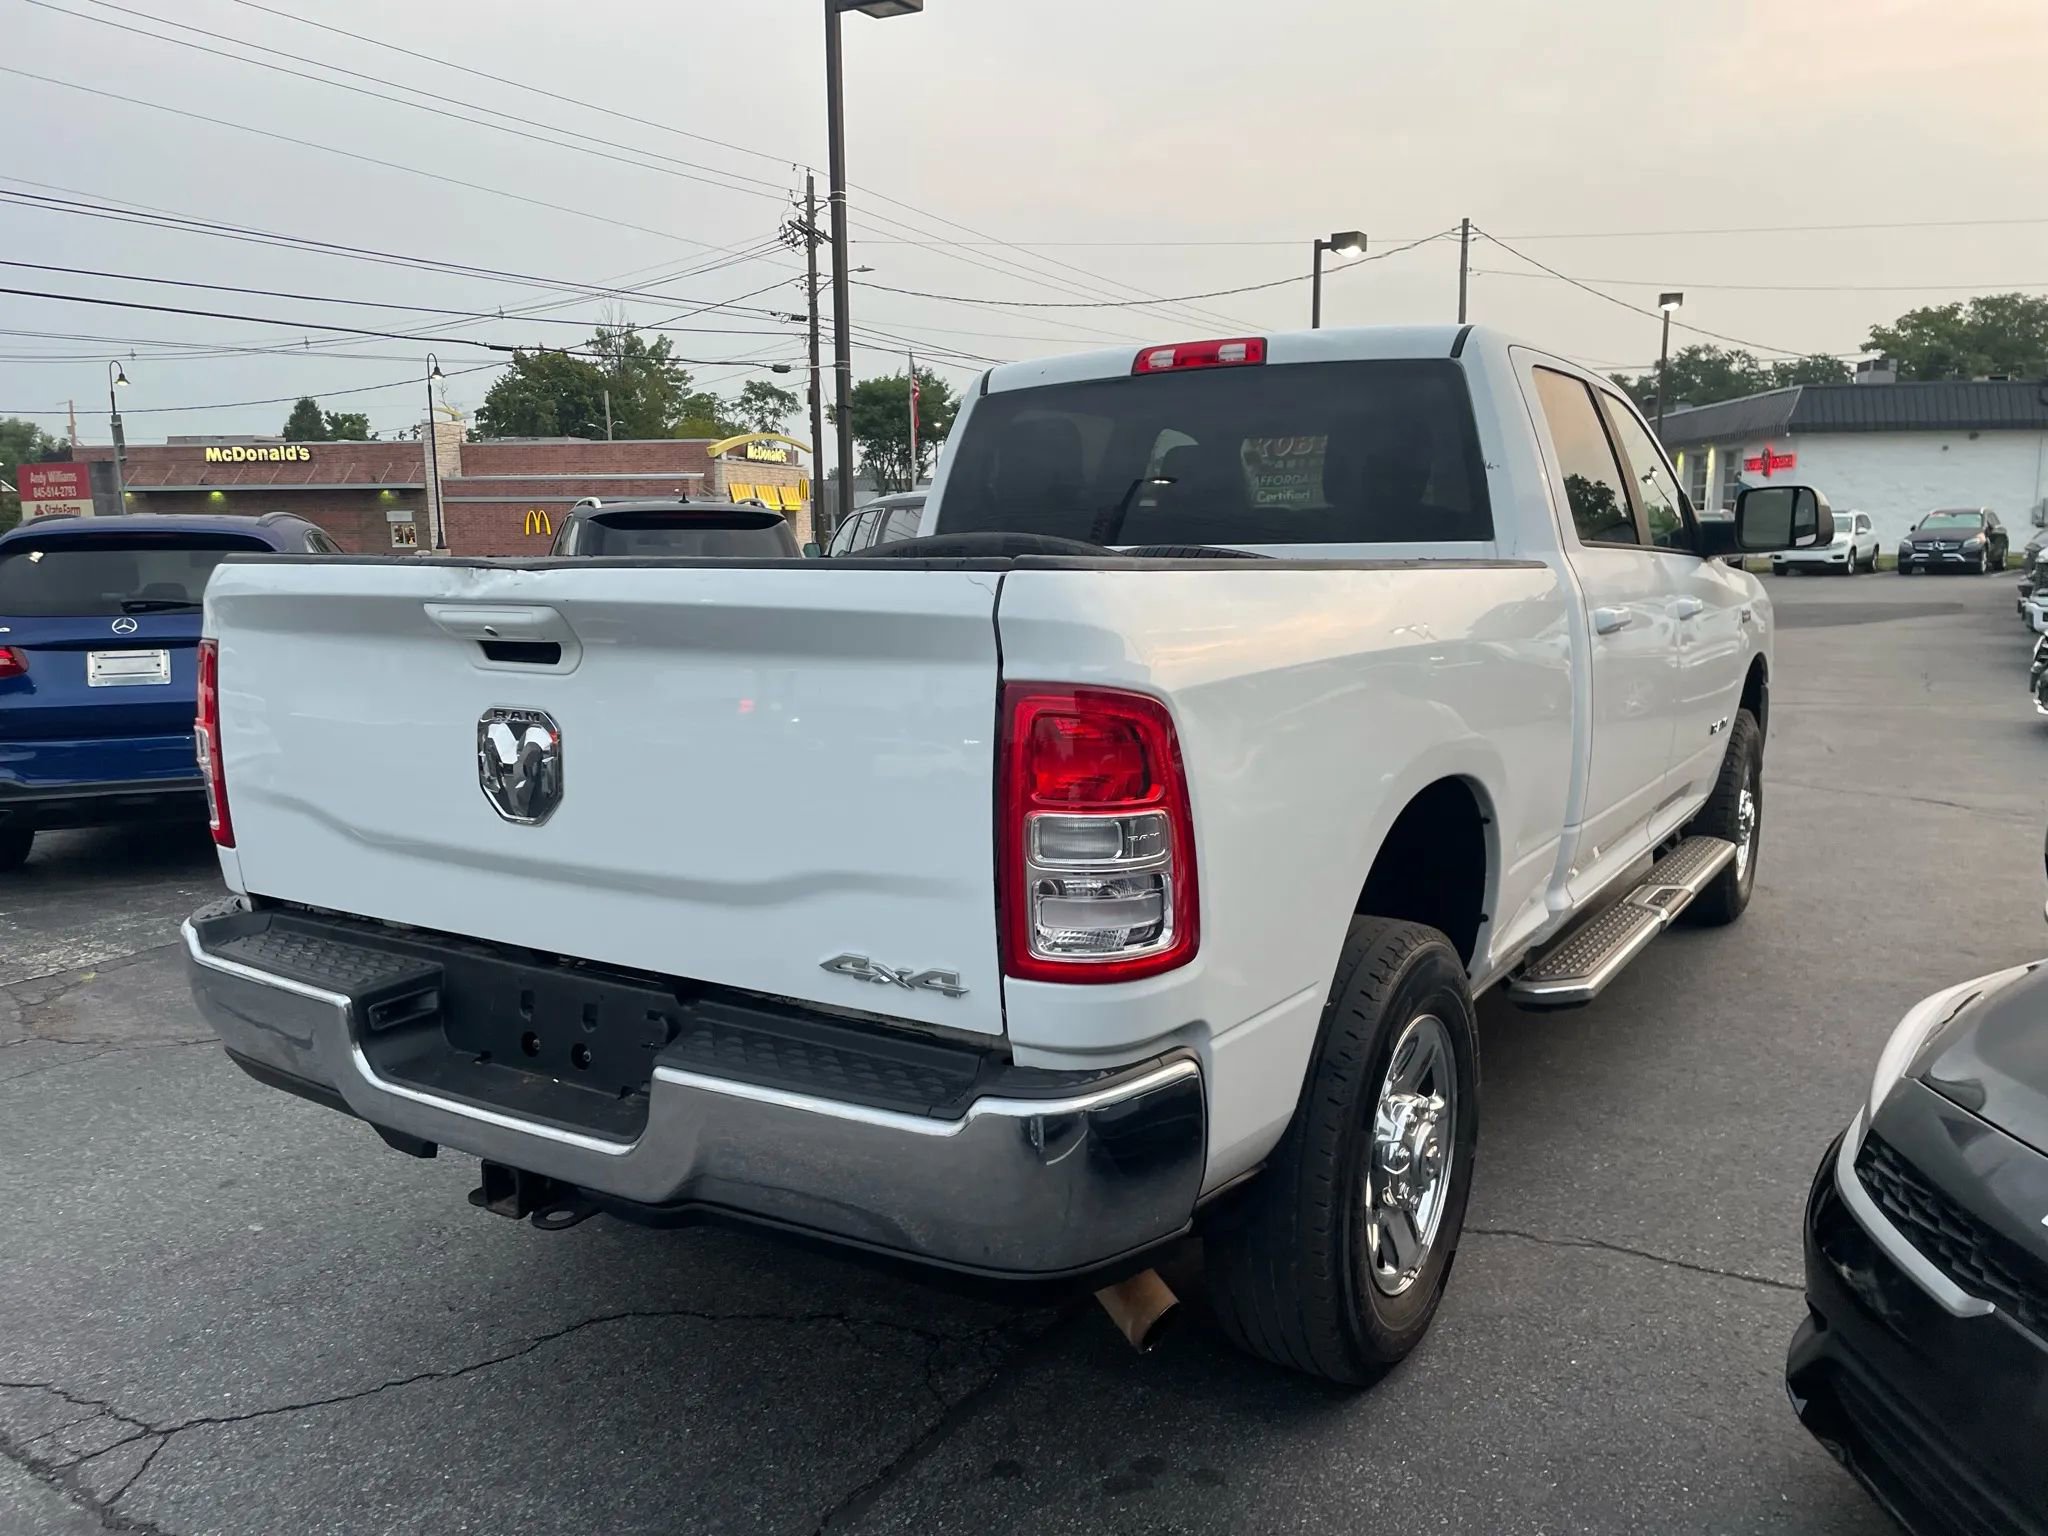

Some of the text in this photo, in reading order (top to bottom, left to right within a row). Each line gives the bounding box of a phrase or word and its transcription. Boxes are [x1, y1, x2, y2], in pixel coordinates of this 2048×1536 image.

[205, 445, 310, 462] McDonald's
[747, 444, 787, 463] McDonald's
[30, 470, 77, 486] Andy Williams
[493, 710, 541, 722] RAM
